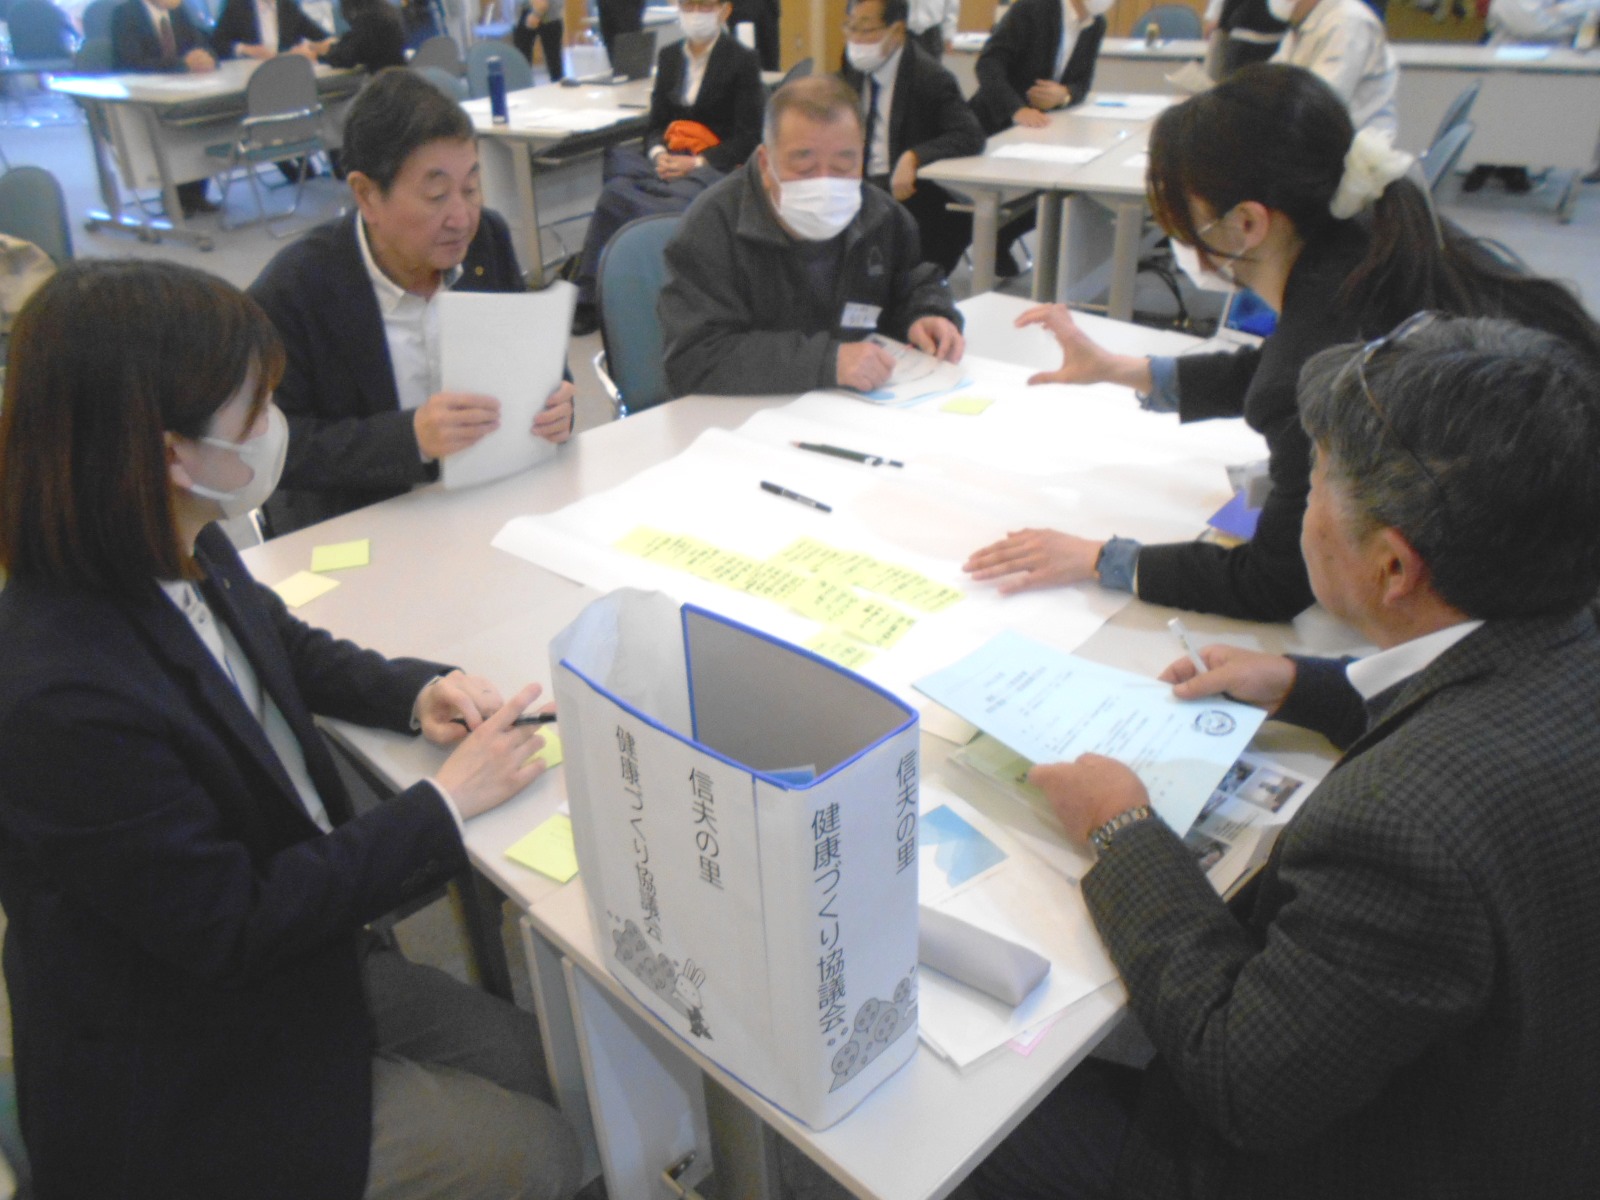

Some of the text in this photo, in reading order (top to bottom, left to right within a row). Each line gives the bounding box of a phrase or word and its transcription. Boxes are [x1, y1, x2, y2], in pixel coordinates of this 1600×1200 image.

[689, 767, 724, 890] 信夫の里
[896, 748, 917, 875] 信夫の里
[811, 802, 846, 1035] 健康づくり協議会
